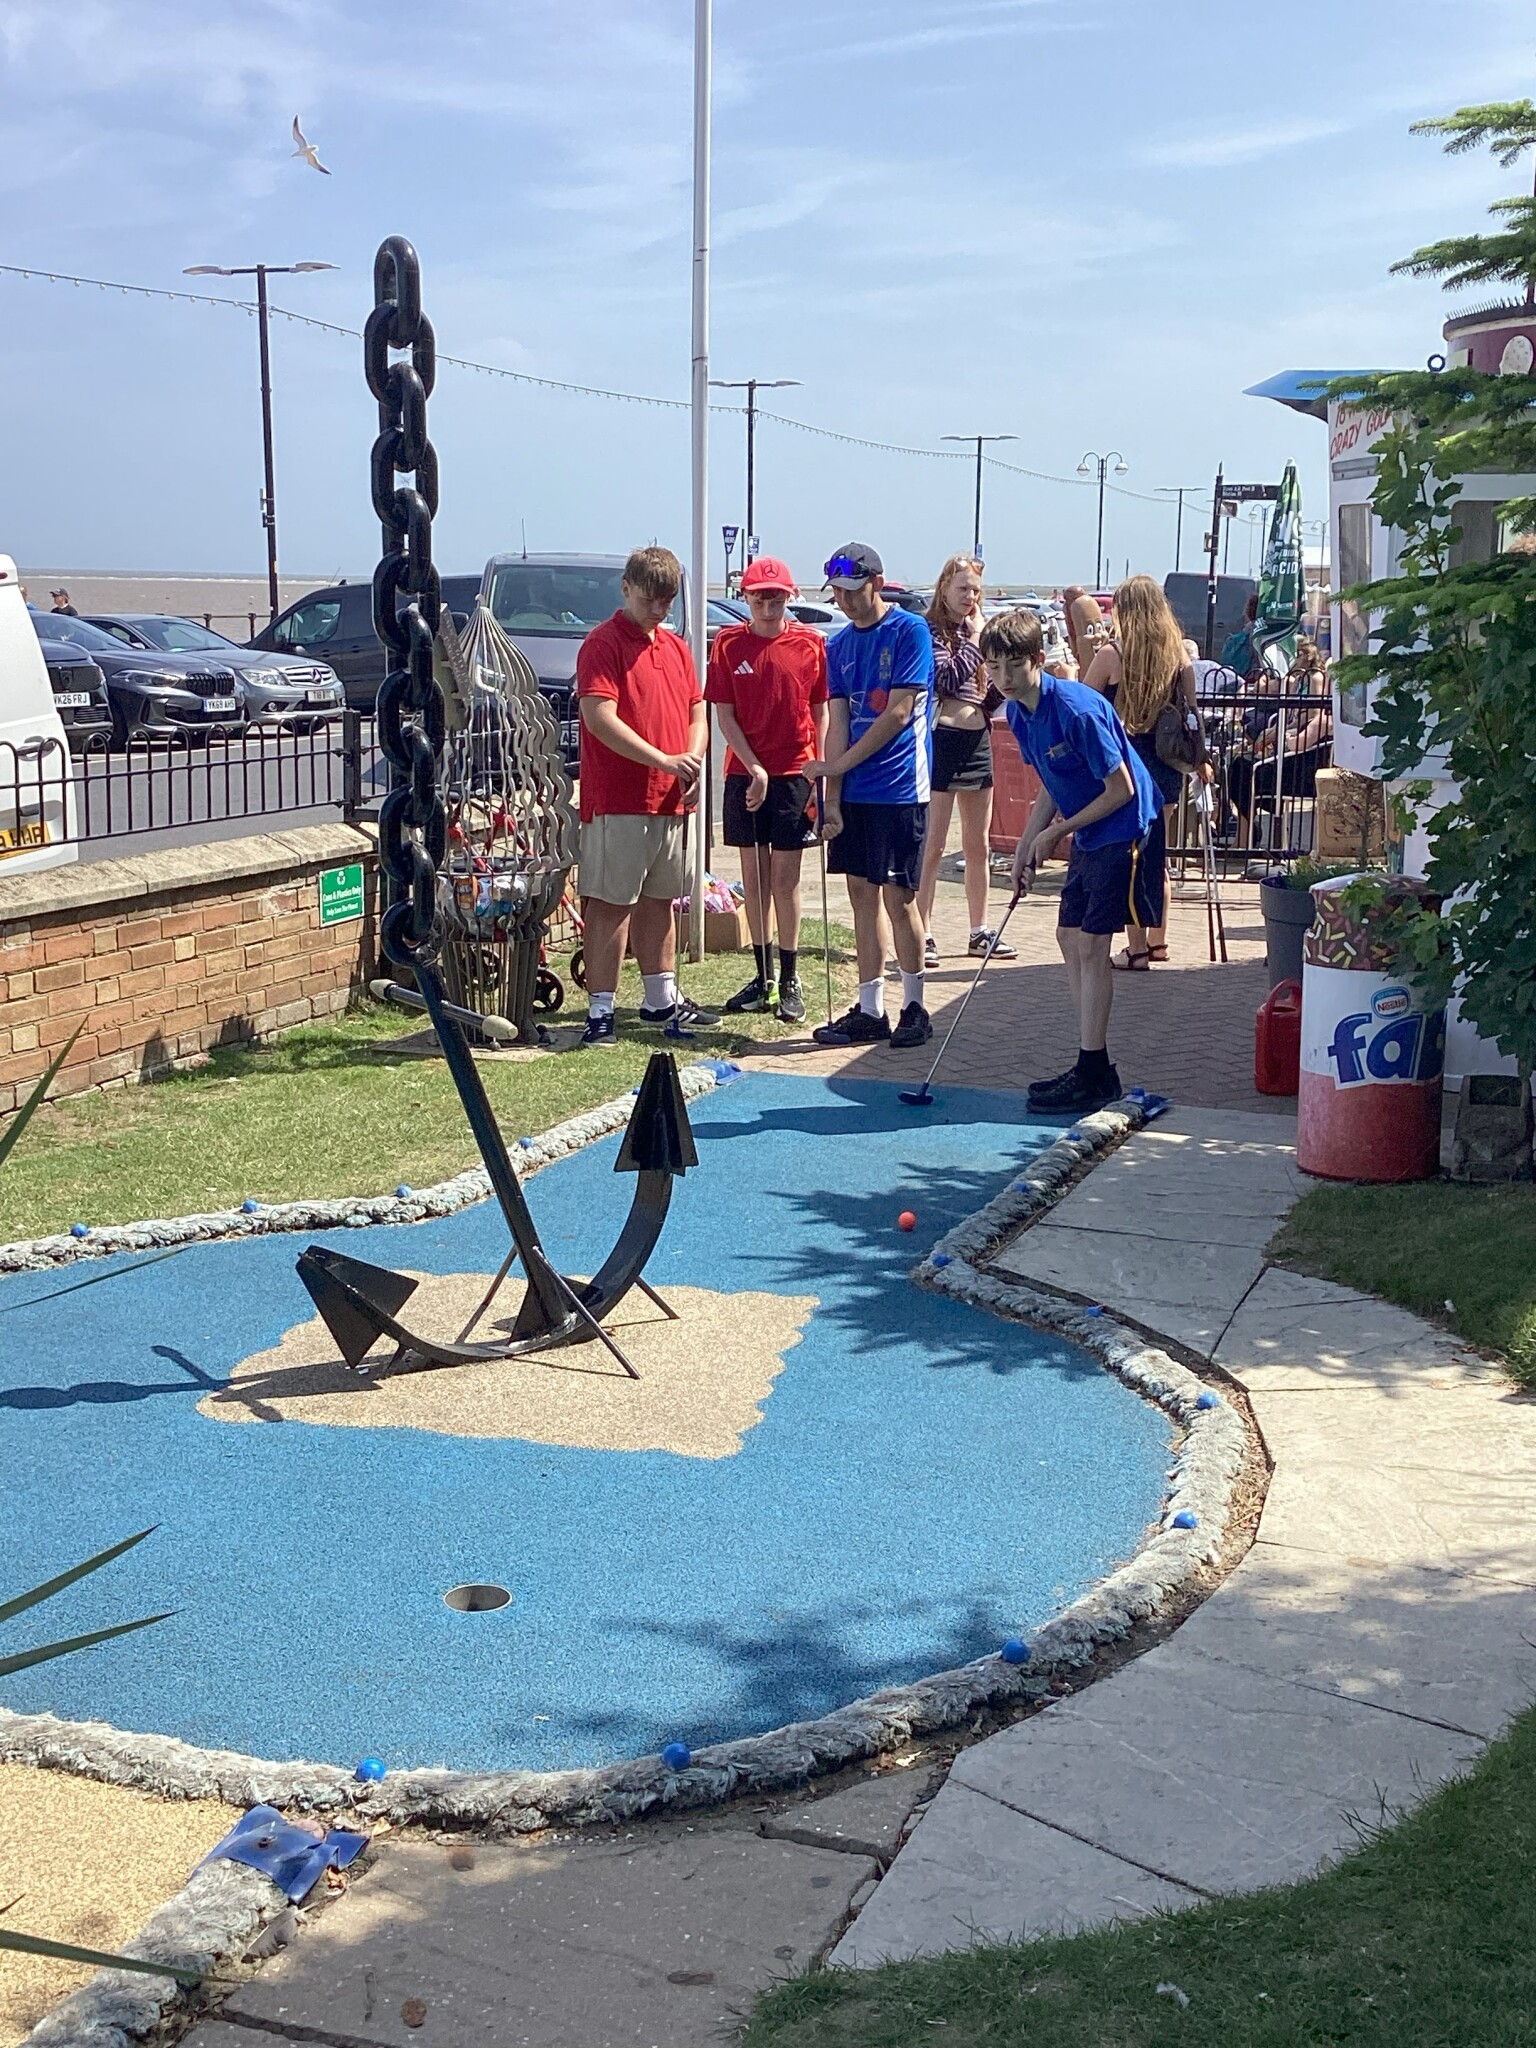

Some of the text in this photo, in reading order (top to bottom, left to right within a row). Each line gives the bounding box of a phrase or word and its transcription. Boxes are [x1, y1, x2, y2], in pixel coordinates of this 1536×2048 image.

[1330, 419, 1362, 460] CRAZY
[1279, 561, 1298, 575] CID
[351, 885, 362, 896] Only
